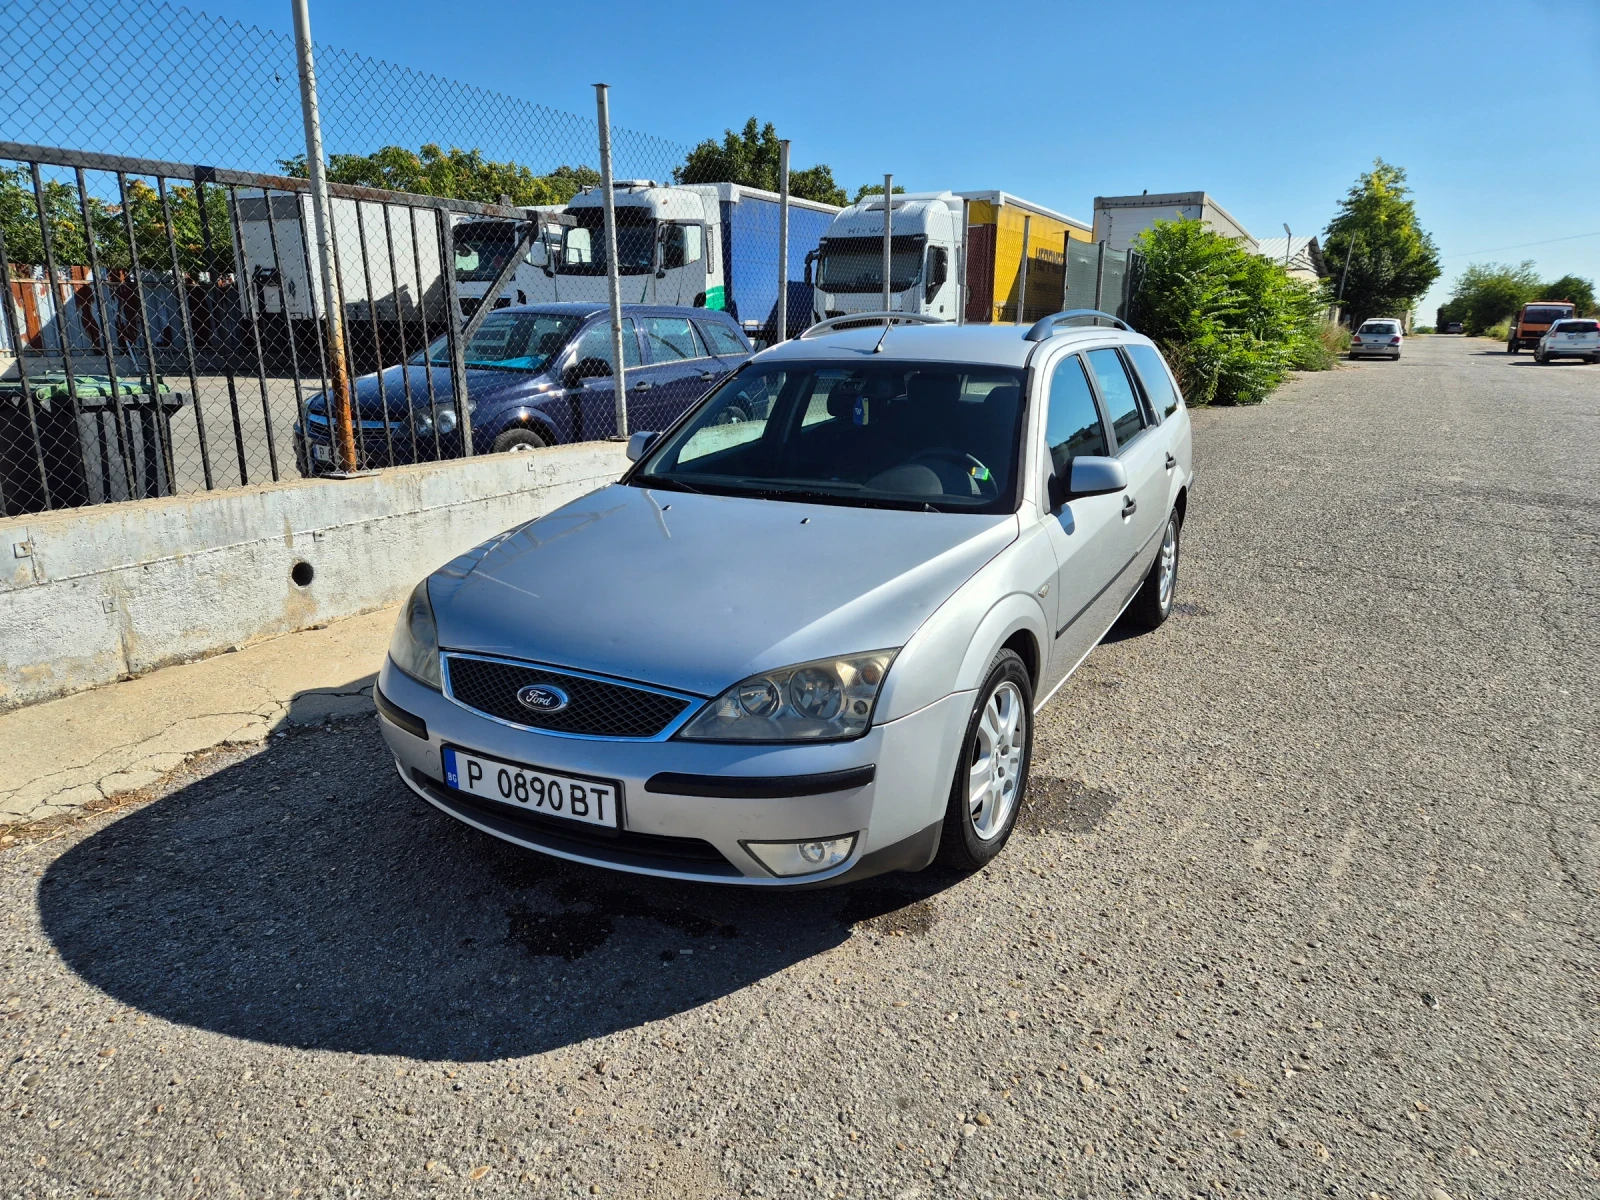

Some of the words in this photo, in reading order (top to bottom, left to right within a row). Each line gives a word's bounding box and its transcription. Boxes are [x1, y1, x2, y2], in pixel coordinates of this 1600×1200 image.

[848, 226, 897, 235] HI-WY
[526, 690, 552, 706] Ford
[448, 772, 457, 783] BG
